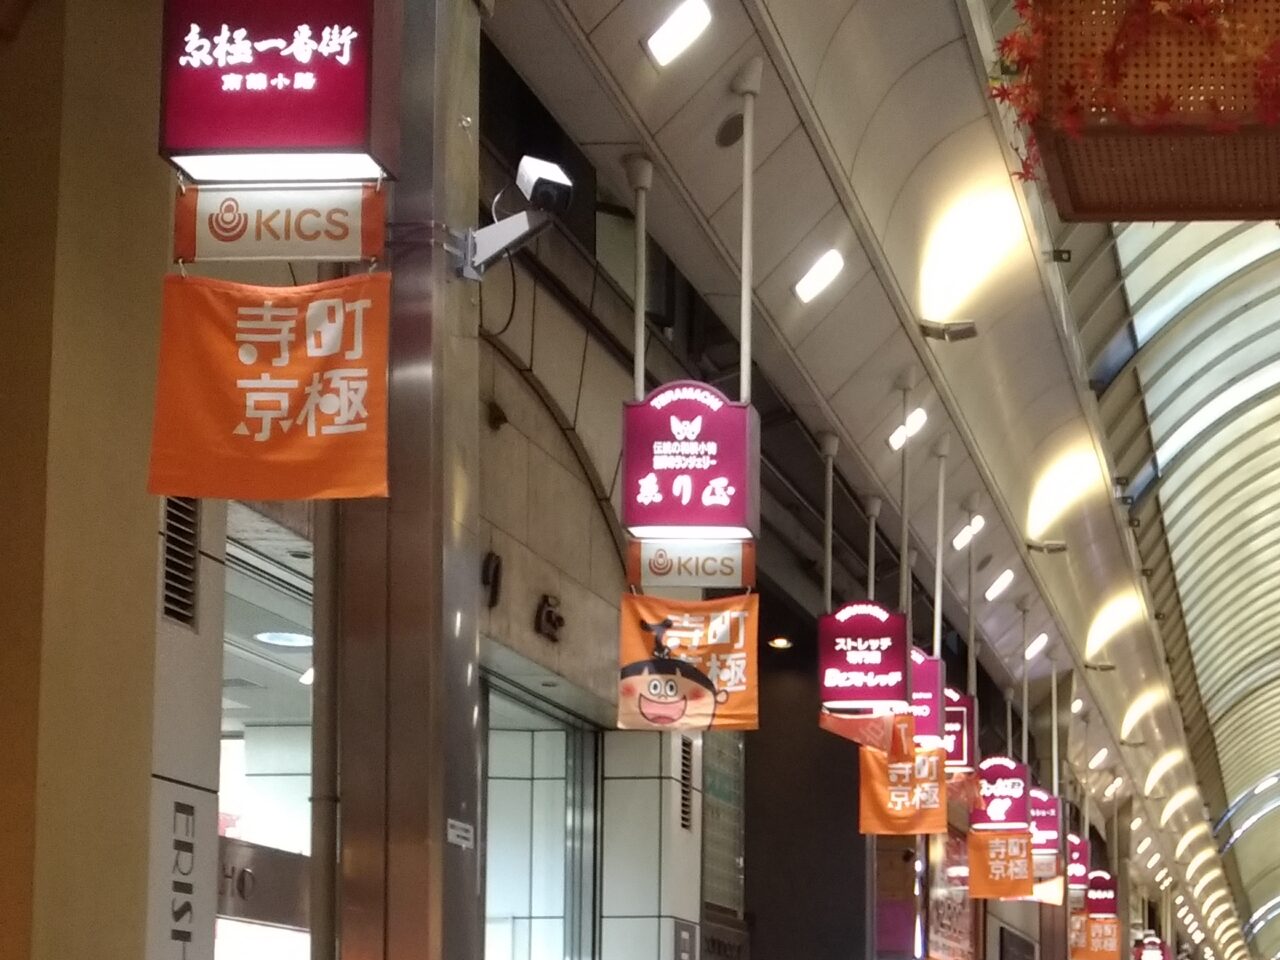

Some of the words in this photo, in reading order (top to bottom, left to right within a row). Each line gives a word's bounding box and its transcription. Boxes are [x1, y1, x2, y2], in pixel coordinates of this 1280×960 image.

[179, 23, 358, 68] 京極一番街
[255, 208, 350, 242] KICS
[236, 298, 373, 367] 寺町
[232, 368, 369, 441] 京極
[677, 556, 735, 577] KICS
[666, 610, 749, 650] 寺町
[834, 637, 892, 651] ストレッチ
[888, 755, 939, 783] 寺町
[887, 782, 939, 811] 京極
